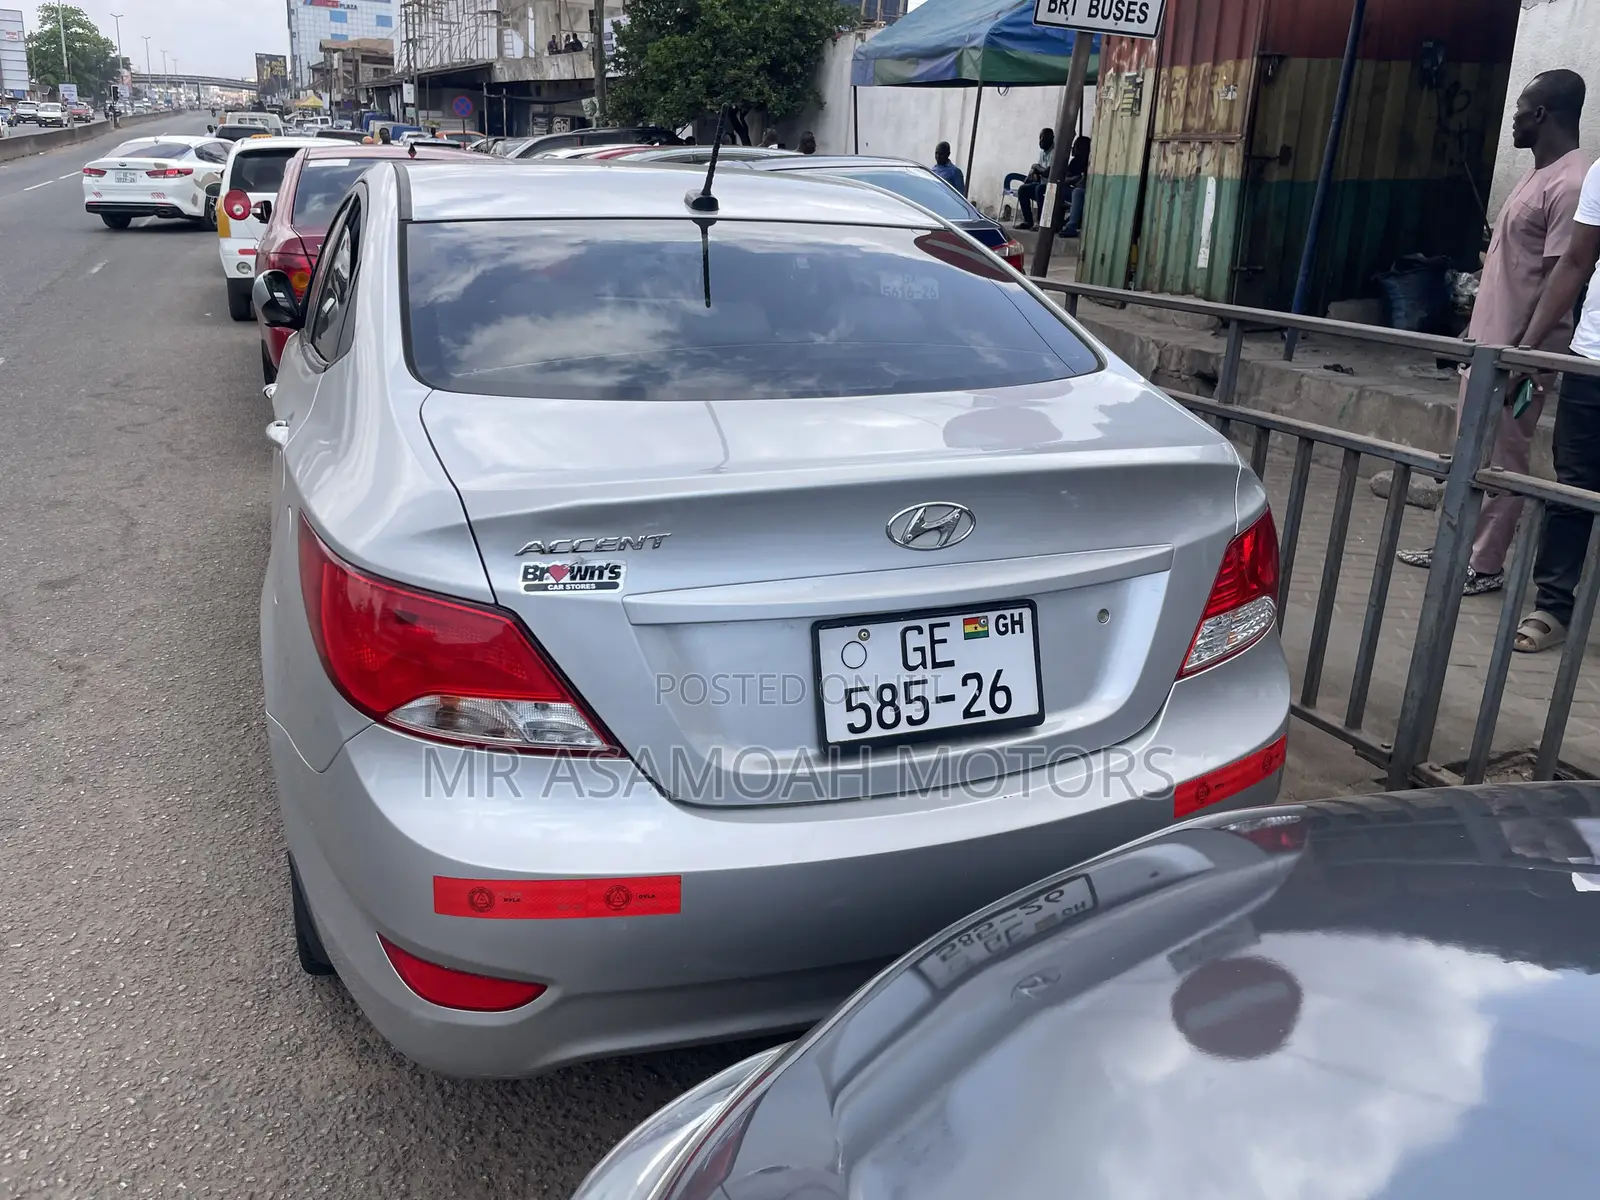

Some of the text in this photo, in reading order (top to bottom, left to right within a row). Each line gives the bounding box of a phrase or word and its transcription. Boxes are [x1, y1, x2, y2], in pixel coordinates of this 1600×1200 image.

[1087, 0, 1150, 24] BUSES
[514, 532, 672, 556] ACCENT
[900, 611, 1025, 672] GE GH
[844, 668, 1013, 735] 585-26
